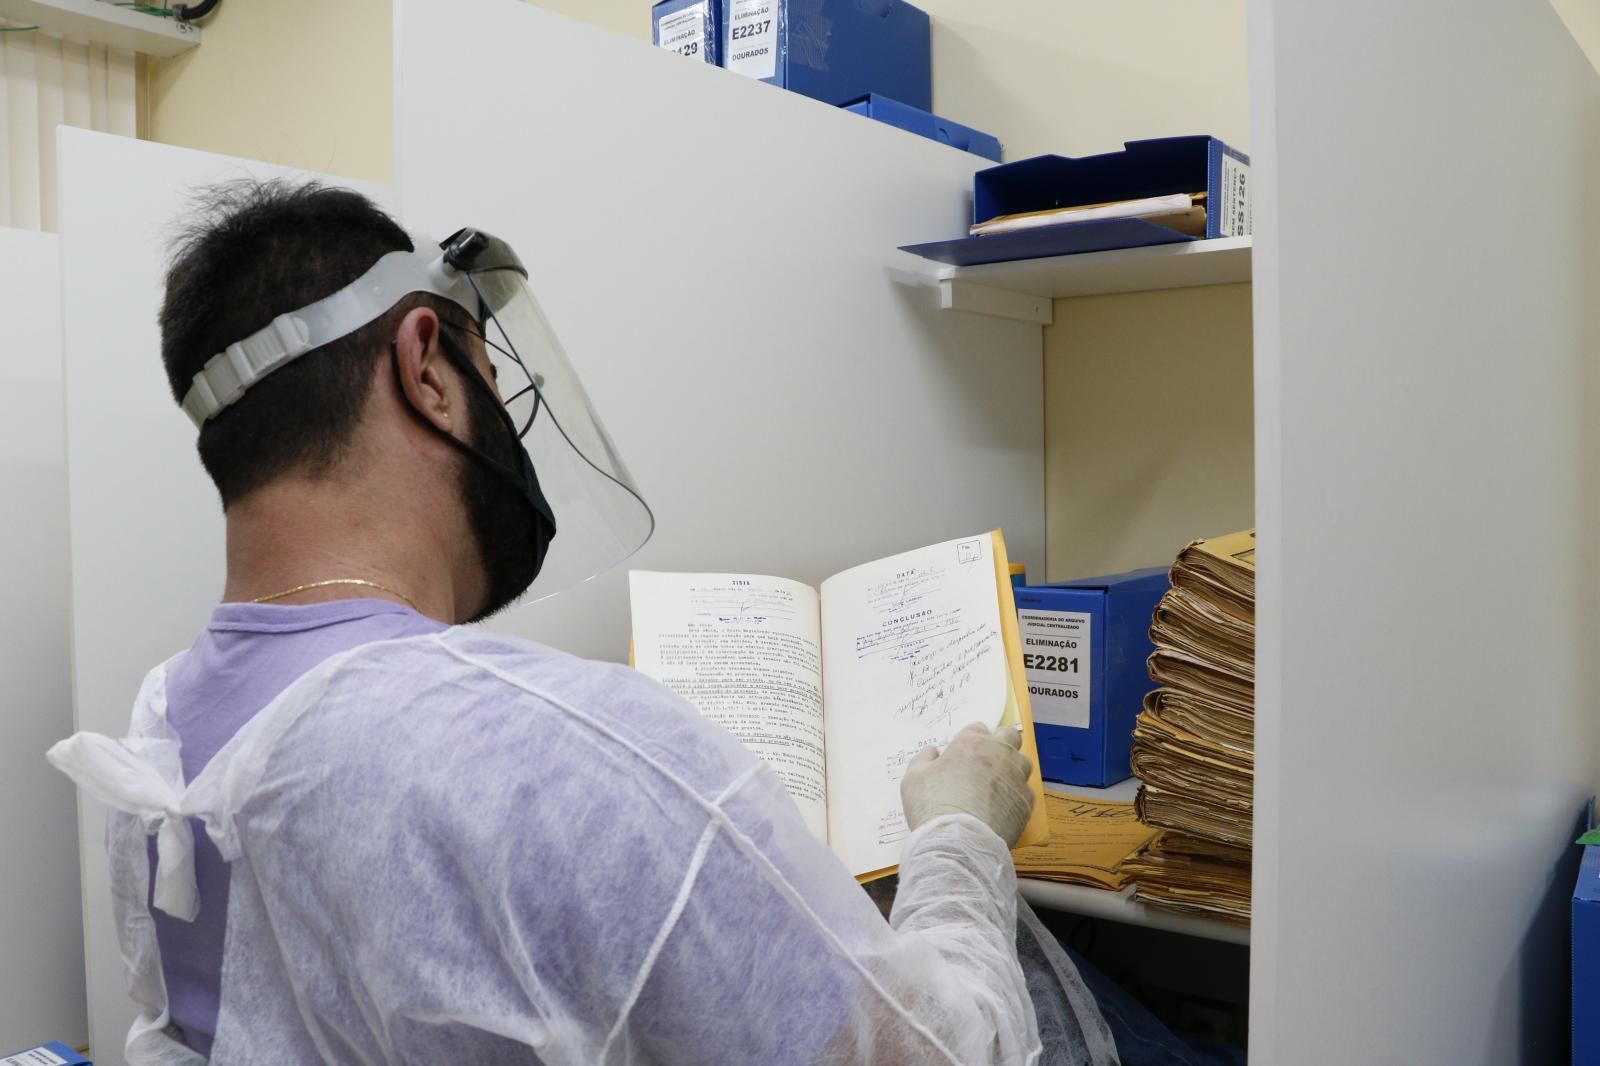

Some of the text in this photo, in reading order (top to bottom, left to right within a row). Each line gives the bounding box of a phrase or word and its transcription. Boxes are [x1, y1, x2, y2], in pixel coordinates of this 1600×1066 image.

[734, 7, 769, 21] ELIMINAÇÃO
[663, 29, 696, 46] ELIMINAÇÃO
[732, 20, 771, 40] E2237
[732, 47, 769, 61] DOURADOS
[1237, 173, 1246, 236] SS126
[1025, 638, 1077, 649] ELIMINAÇÃO
[1023, 653, 1079, 673] E2281
